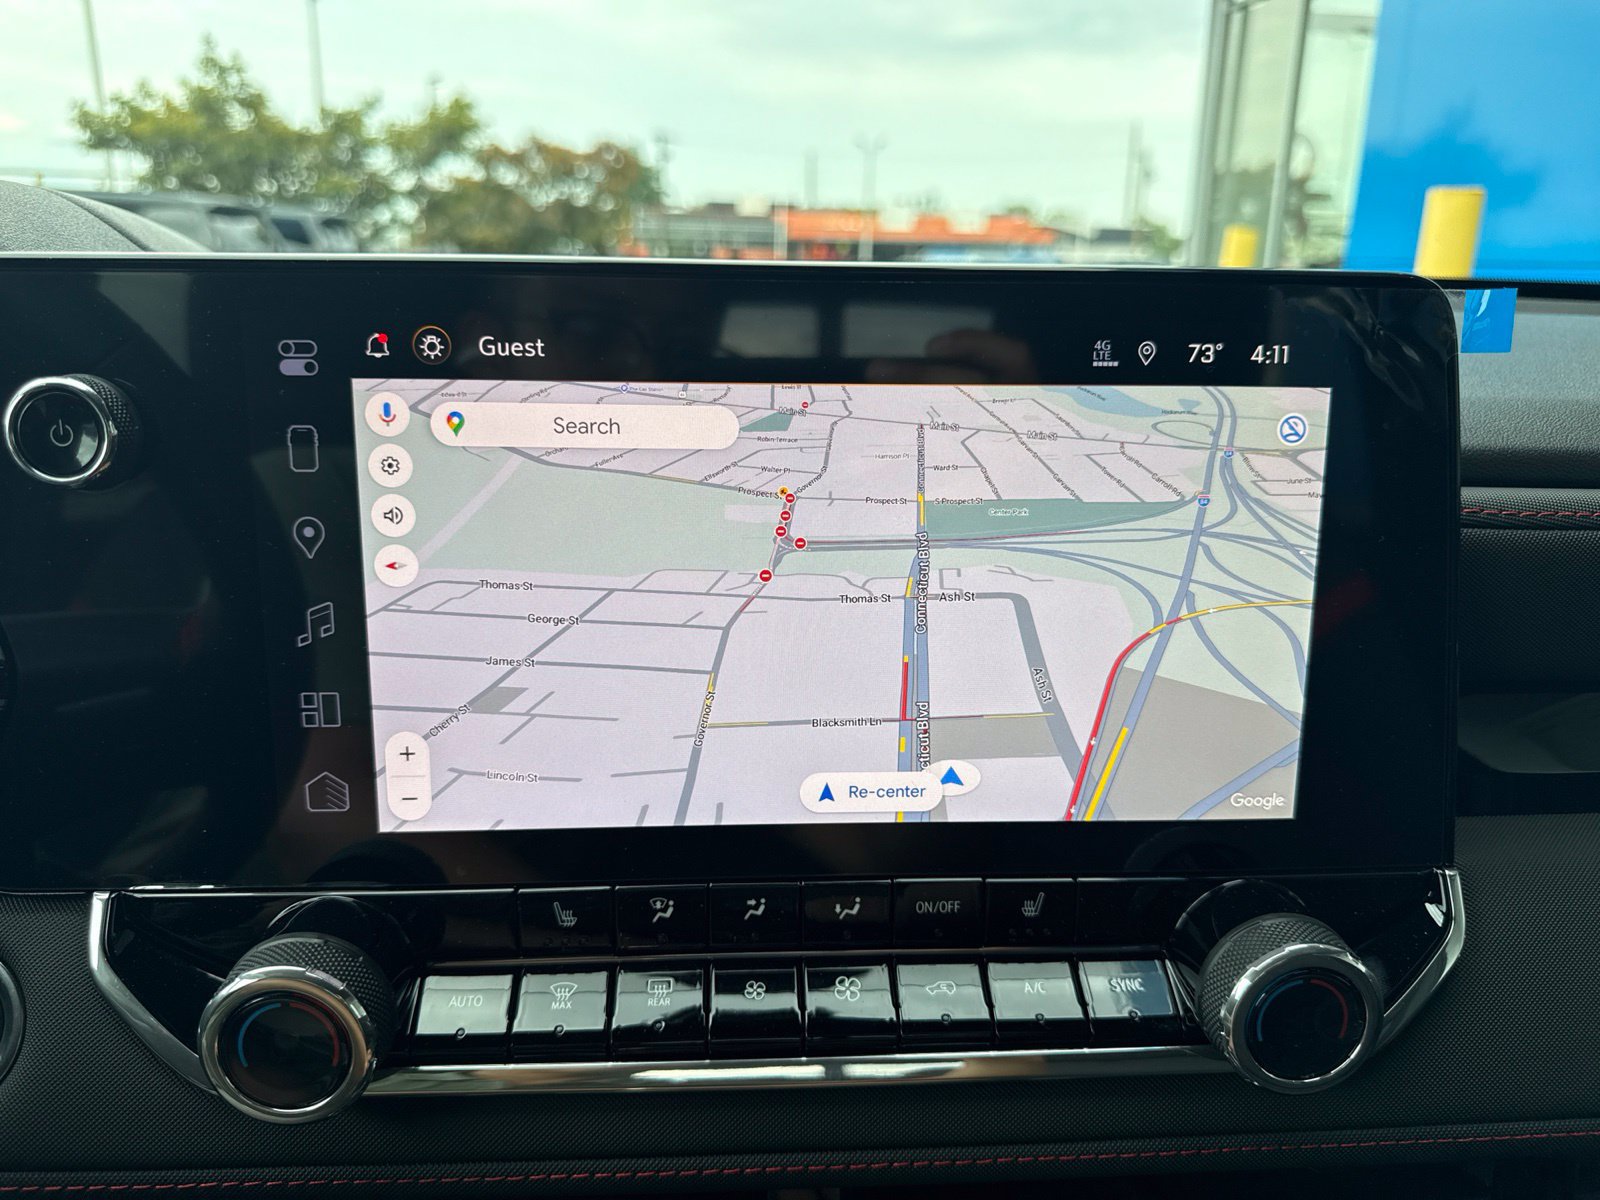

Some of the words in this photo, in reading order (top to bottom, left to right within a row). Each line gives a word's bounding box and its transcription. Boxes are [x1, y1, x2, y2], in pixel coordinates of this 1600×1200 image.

[479, 336, 545, 357] Guest
[1094, 340, 1112, 351] 4G
[1093, 351, 1112, 361] LTE
[1187, 342, 1225, 364] 73°
[1250, 344, 1290, 364] 4:11
[553, 416, 621, 434] Search
[930, 421, 950, 431] Main
[950, 423, 960, 431] St
[1027, 430, 1047, 441] Main
[1047, 432, 1058, 441] St
[761, 466, 783, 474] Walter
[980, 466, 996, 488] Chapel
[1101, 466, 1118, 482] Tower
[1116, 478, 1125, 488] Rd
[797, 472, 824, 494] Governor
[819, 465, 828, 476] St
[1053, 473, 1072, 492] Garvan
[1068, 489, 1077, 498] St
[1151, 472, 1174, 491] Carroll
[1171, 487, 1182, 497] Rd
[738, 486, 773, 498] Prospect
[865, 496, 899, 505] Prospect
[899, 497, 908, 505] St
[941, 497, 974, 506] Prospect
[988, 507, 1011, 516] Center
[1011, 507, 1029, 516] Park
[916, 531, 929, 558] Blvd
[479, 579, 519, 591] Thomas
[521, 580, 534, 591] St
[840, 593, 878, 605] Thomas
[881, 593, 891, 604] St
[915, 559, 929, 635] Connecticut
[938, 591, 961, 602] Ash
[963, 591, 975, 602] St
[527, 613, 566, 627] George
[567, 615, 580, 626] St
[485, 656, 521, 668] James
[523, 657, 535, 668] St
[1032, 667, 1046, 690] Ash
[1041, 688, 1053, 703] St
[429, 710, 460, 738] Cherry
[457, 703, 471, 717] St
[693, 703, 714, 748] Governor
[704, 690, 716, 703] St
[812, 717, 866, 728] Blacksmith
[870, 717, 882, 727] Ln
[916, 702, 929, 730] Blvd
[486, 769, 525, 782] Lincoln
[527, 771, 538, 783] St
[848, 784, 926, 799] Re-center
[1230, 792, 1285, 809] Google
[915, 901, 961, 914] ON/OFF
[1024, 981, 1046, 994] A/C
[1109, 979, 1146, 993] SYNC
[448, 995, 483, 1008] AUTO
[552, 1001, 572, 1010] MAX
[648, 997, 671, 1007] REAR
